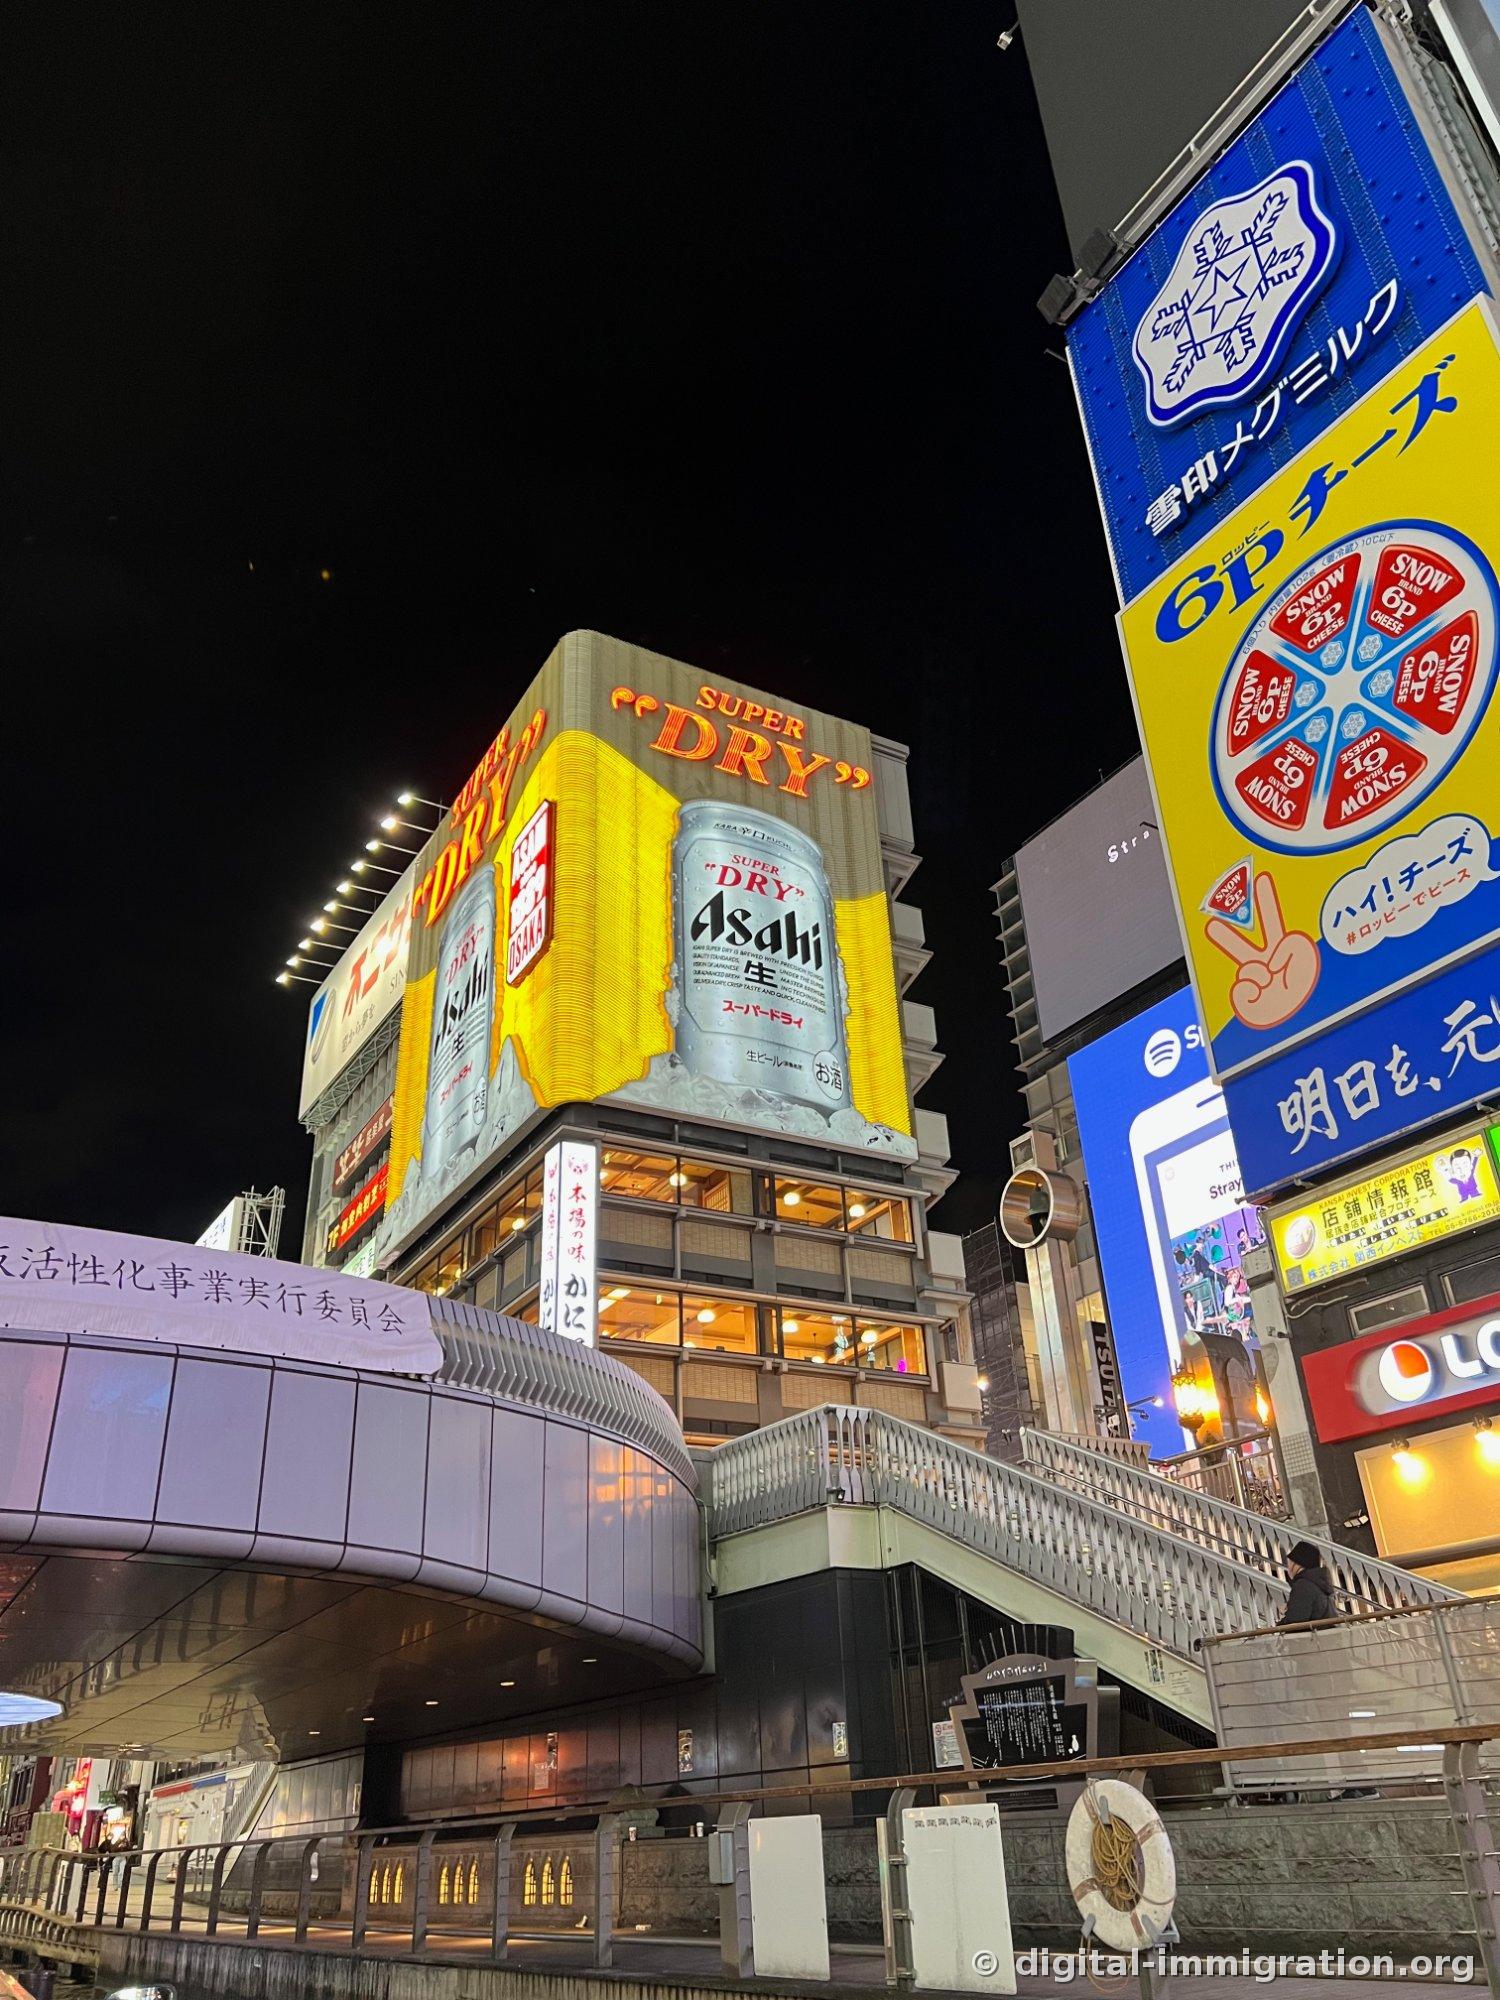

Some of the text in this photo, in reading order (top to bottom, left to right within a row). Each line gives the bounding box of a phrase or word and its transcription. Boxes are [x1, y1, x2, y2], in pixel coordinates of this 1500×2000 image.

[1145, 279, 1400, 537] 雪印メグミルク
[1221, 520, 1271, 566] ロッピー
[1285, 564, 1346, 624] SNOW
[1390, 553, 1453, 594] SNOW
[1300, 602, 1342, 635] 6P
[1370, 609, 1405, 635] CHEESE
[1381, 586, 1417, 620] 6P
[1307, 616, 1345, 649] CHEESE
[1276, 675, 1294, 720] CHEESE
[1396, 656, 1416, 704] CHEESE
[1411, 650, 1439, 704] 6P
[1437, 634, 1472, 715] SNOW
[696, 685, 806, 740] SUPER
[1232, 666, 1262, 737] SNOW
[1256, 676, 1281, 724] 6P
[1284, 740, 1316, 767] CHEESE
[1340, 730, 1381, 763] CHEESE
[1343, 746, 1390, 781] 6P
[449, 727, 511, 832] SUPER
[1274, 753, 1306, 790] 6P
[1340, 762, 1408, 821] SNOW
[1244, 775, 1298, 822] SNOW
[731, 854, 780, 876] SUPER
[1215, 871, 1242, 903] SNOW
[508, 906, 543, 976] OSAKA
[690, 890, 823, 971] Asahi
[743, 959, 778, 989] 生
[433, 947, 489, 1058] Asahi
[722, 999, 804, 1030] スーパードライ
[1277, 993, 1500, 1155] 明日を、元
[1208, 1177, 1243, 1200] Stray
[1219, 1159, 1240, 1174] THI
[1318, 1159, 1429, 1210] KANSAI INVEST CORPORATION
[1321, 1168, 1434, 1229] 店舗情報館
[567, 1182, 588, 1264] 本場の味
[563, 1272, 588, 1343] かに
[1094, 1332, 1121, 1438] TSUTA
